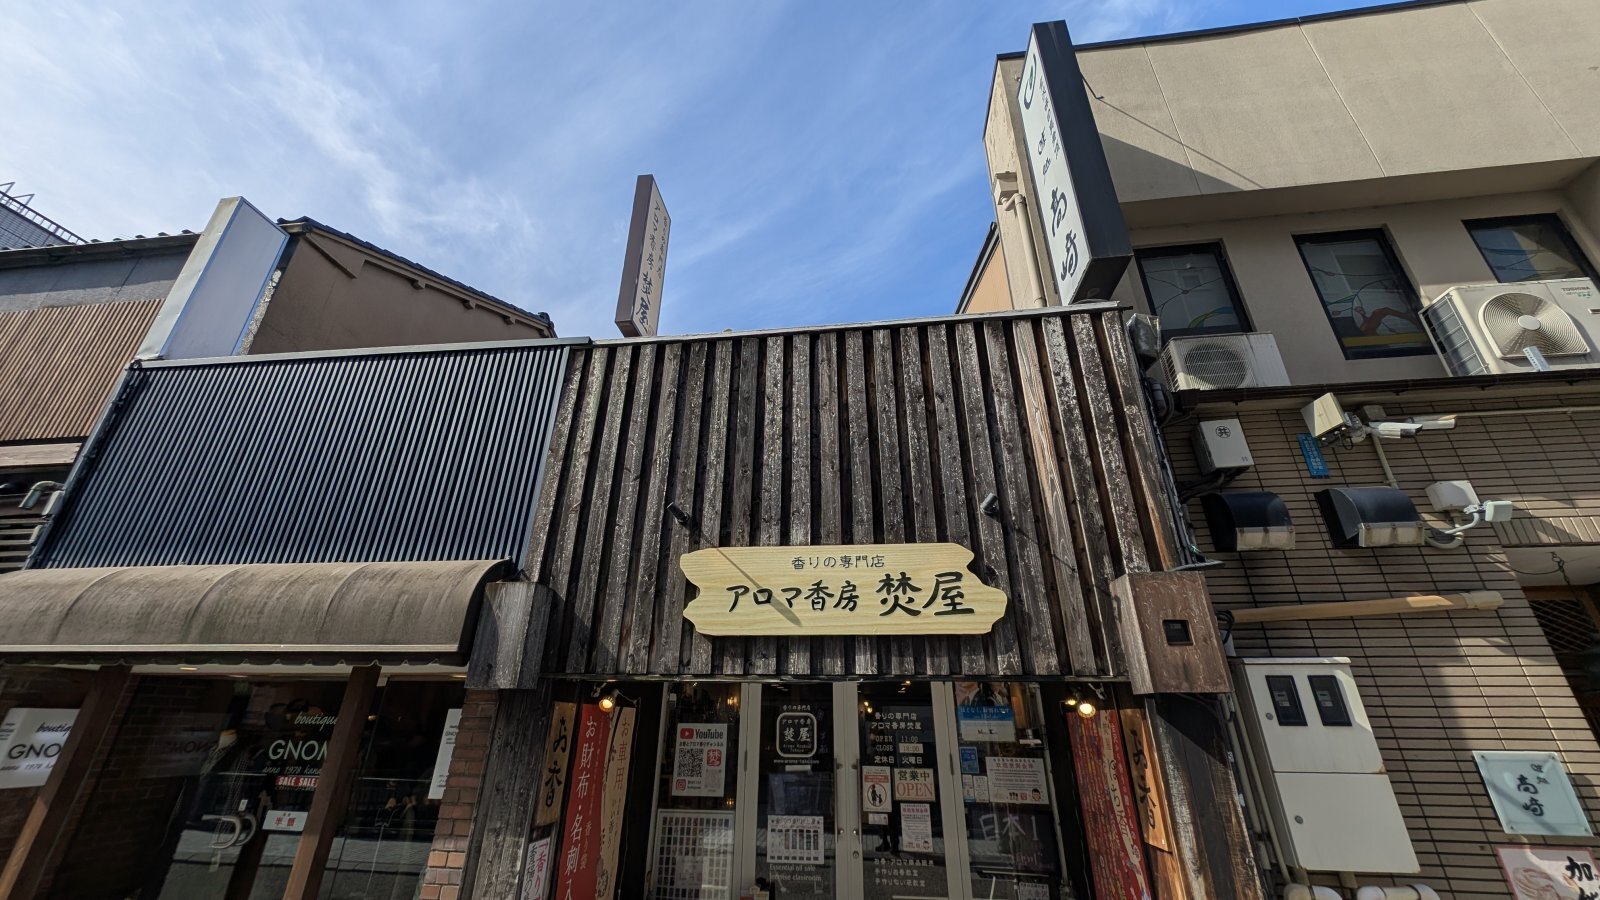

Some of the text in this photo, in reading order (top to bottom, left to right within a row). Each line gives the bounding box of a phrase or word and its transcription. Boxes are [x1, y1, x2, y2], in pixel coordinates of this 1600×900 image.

[791, 554, 885, 570] 香りの専門店
[875, 571, 976, 617] 焚屋
[874, 712, 917, 720] 香りの専門店
[695, 728, 724, 740] YouTube
[875, 744, 894, 752] CLOSE
[544, 716, 568, 808] お香
[874, 755, 895, 764] 定休日
[278, 776, 316, 787] SALE SALE
[897, 770, 930, 782] 営業中
[896, 782, 933, 797] OPEN
[770, 863, 795, 871] Essential
